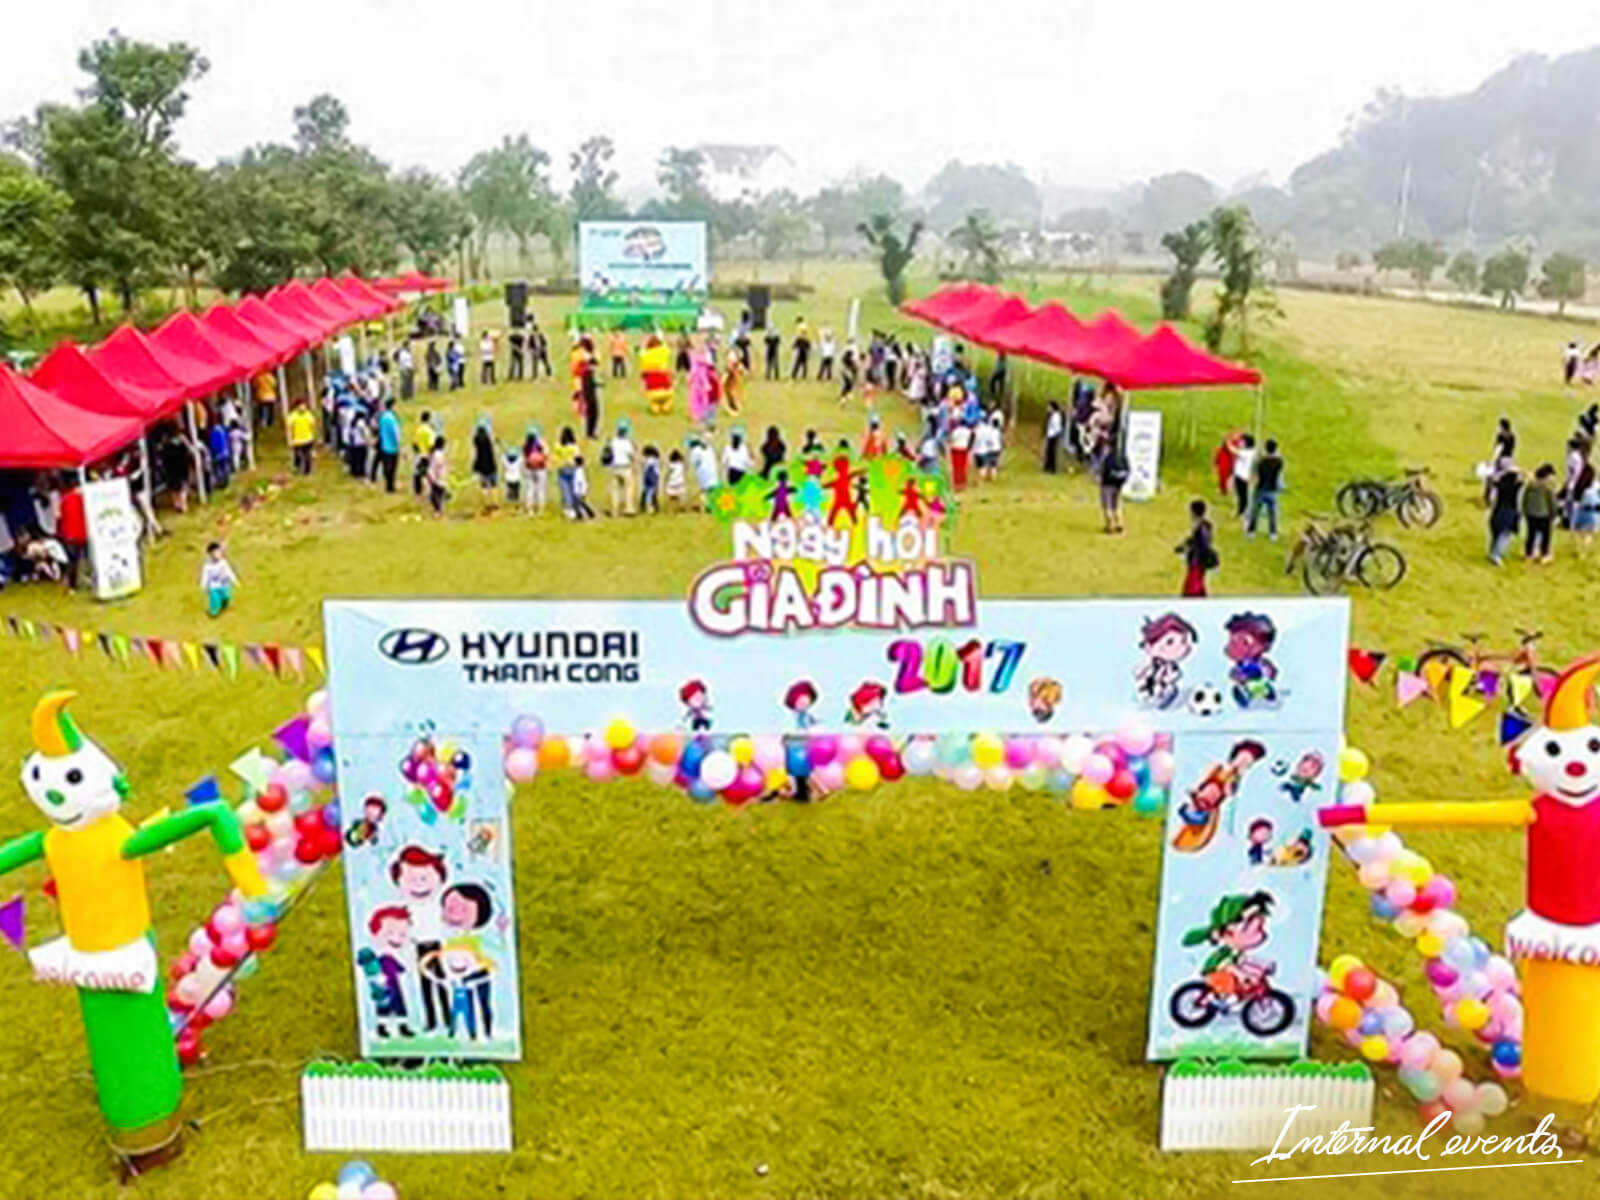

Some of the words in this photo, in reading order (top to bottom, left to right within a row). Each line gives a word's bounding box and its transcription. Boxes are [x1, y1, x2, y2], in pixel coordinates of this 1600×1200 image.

[733, 512, 850, 565] Ngày
[461, 631, 639, 659] HYUNDAI
[464, 663, 560, 683] THANH
[567, 663, 640, 683] CONG
[887, 637, 1026, 694] 2017
[1507, 933, 1600, 966] welco
